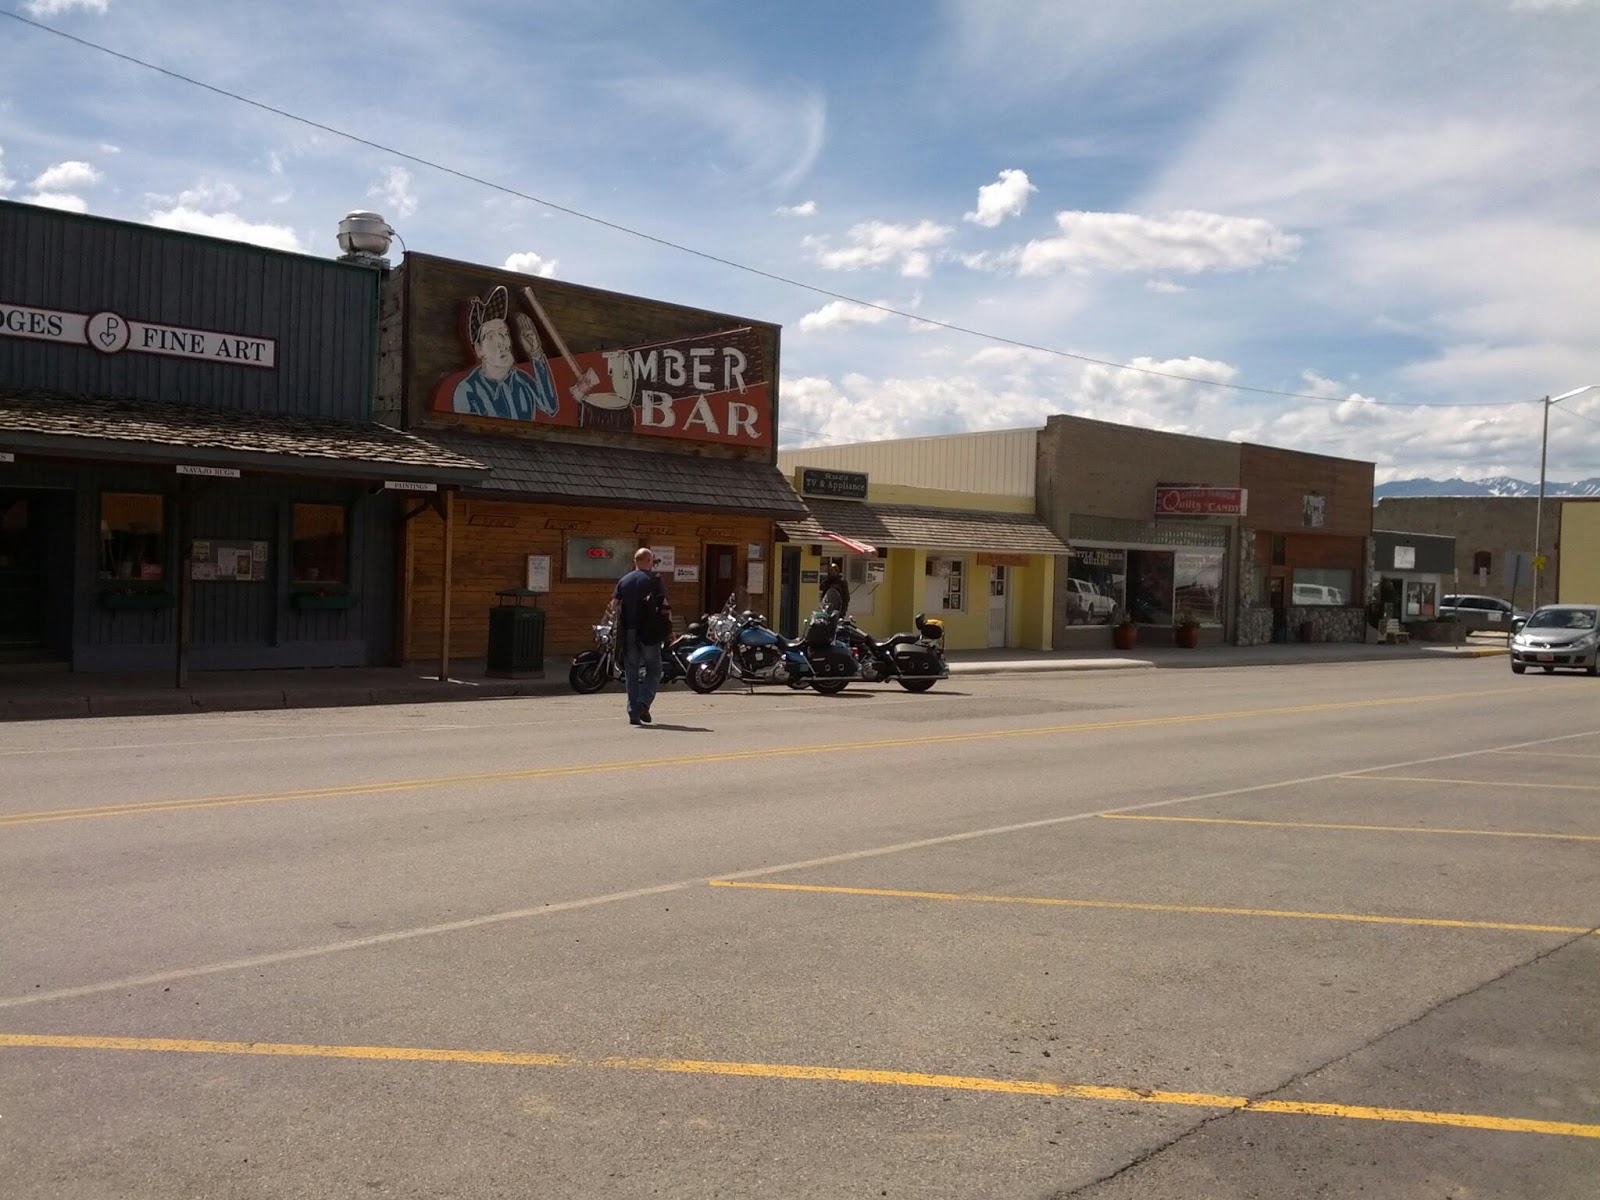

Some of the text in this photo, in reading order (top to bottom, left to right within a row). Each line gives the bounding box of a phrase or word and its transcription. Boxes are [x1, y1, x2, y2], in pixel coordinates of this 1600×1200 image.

[0, 309, 63, 336] GES
[142, 327, 266, 362] FINE ART
[602, 346, 748, 394] TIMBER
[641, 389, 762, 439] BAR
[183, 466, 235, 476] NAVAJO RUGS
[394, 482, 428, 490] PAINTINGS
[806, 479, 817, 487] TV
[828, 481, 865, 491] Appliance
[1207, 502, 1241, 512] CANDY
